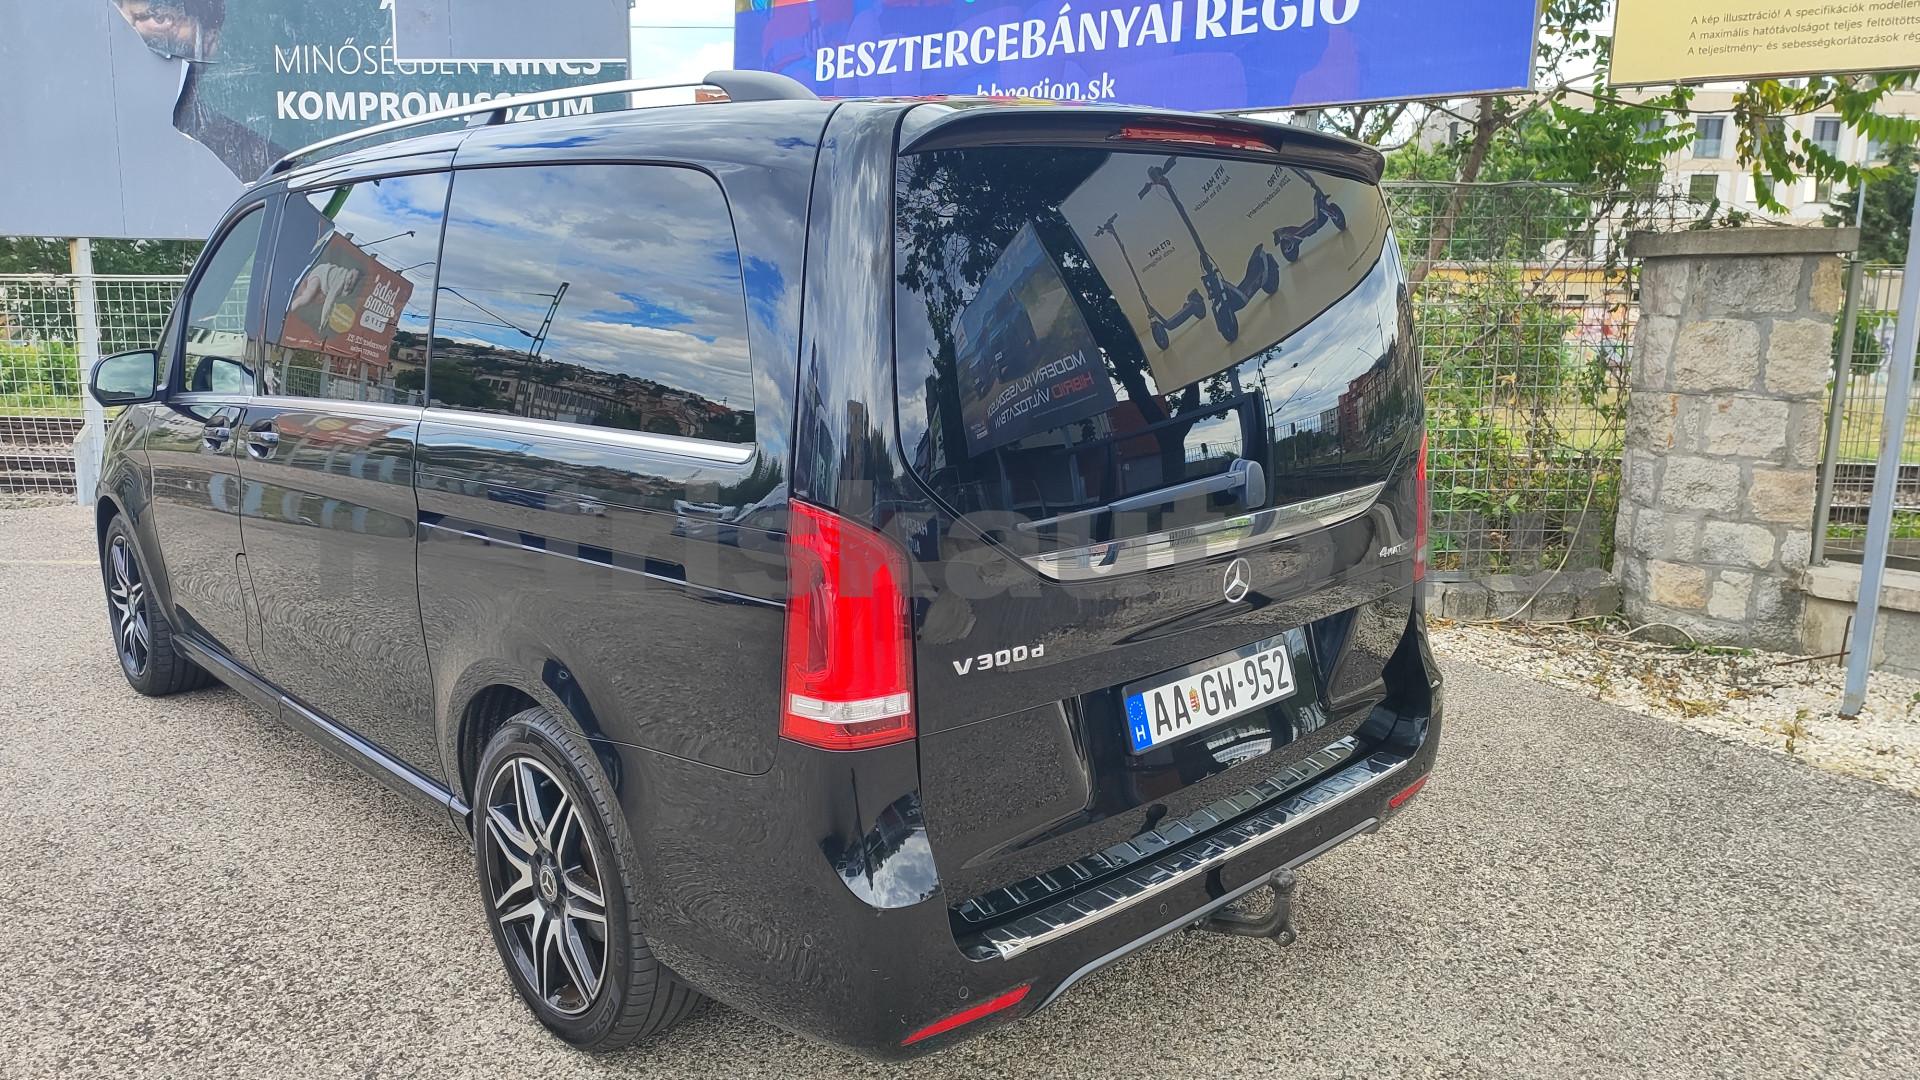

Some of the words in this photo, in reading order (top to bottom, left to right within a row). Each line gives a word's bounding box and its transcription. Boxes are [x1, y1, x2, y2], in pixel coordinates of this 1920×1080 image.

[1690, 16, 1698, 25] A
[1701, 15, 1720, 26] kép
[1723, 9, 1781, 23] illusztráció!
[1784, 8, 1792, 18] A
[1795, 3, 1865, 19] specifikációk
[1689, 31, 1697, 40] A
[1700, 27, 1750, 40] maximális
[1752, 22, 1830, 36] hatótávolságot
[1833, 19, 1862, 31] teljes
[815, 1, 1182, 82] BESZTERCEBÁNYAI
[1687, 46, 1695, 56] A
[1698, 43, 1763, 57] teljesítmény-
[1766, 41, 1778, 50] és
[1782, 32, 1900, 50] sebességkorlátozások
[1135, 724, 1147, 743] H
